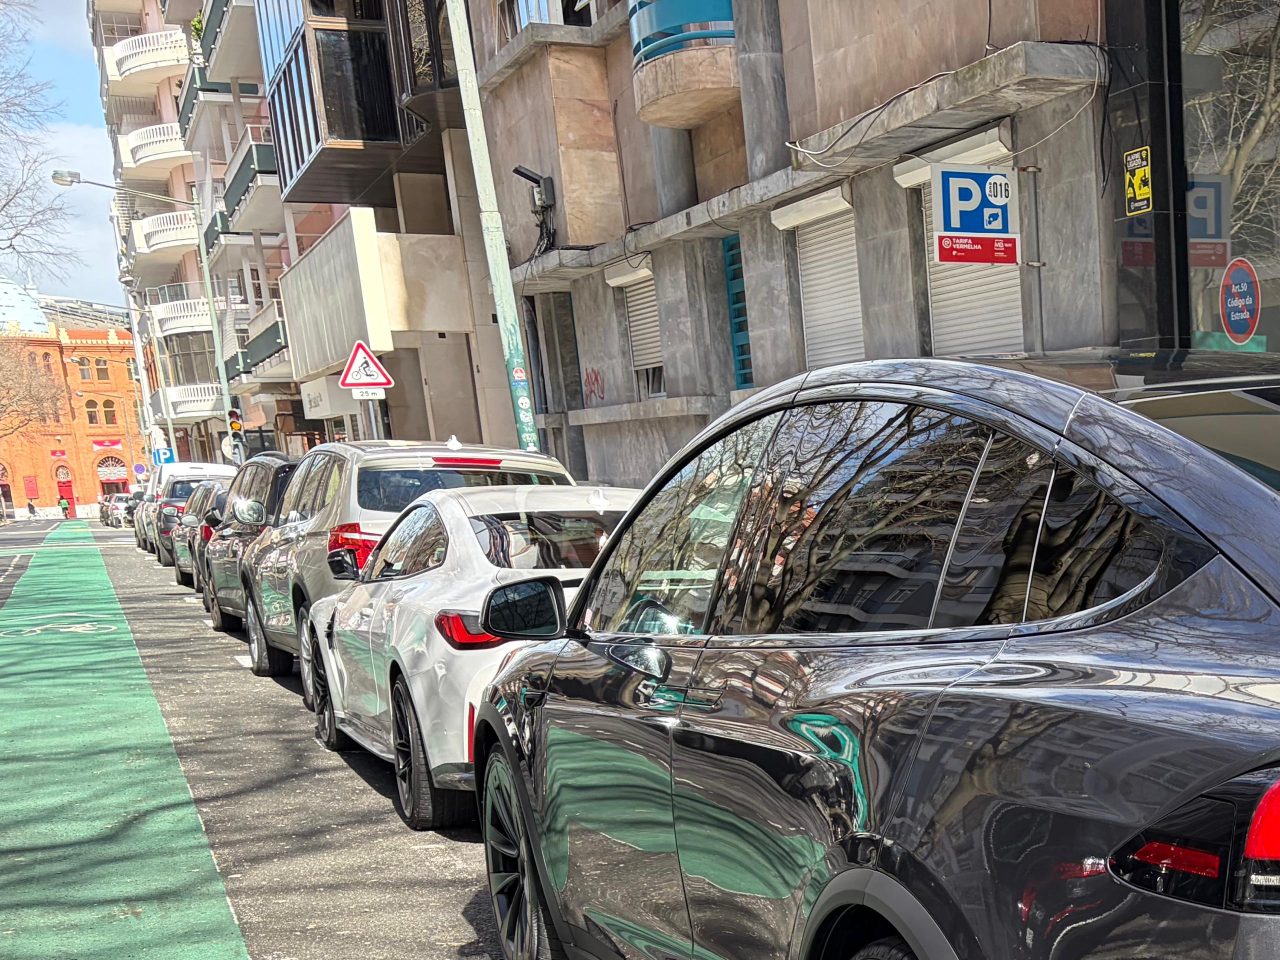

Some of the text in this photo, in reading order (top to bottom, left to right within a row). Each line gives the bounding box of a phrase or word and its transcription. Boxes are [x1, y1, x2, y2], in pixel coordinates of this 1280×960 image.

[993, 182, 1010, 198] 016
[949, 177, 982, 228] P
[1231, 284, 1248, 293] Art.50
[1227, 295, 1253, 308] Código da
[1231, 311, 1250, 321] Estrada
[159, 450, 170, 462] P
